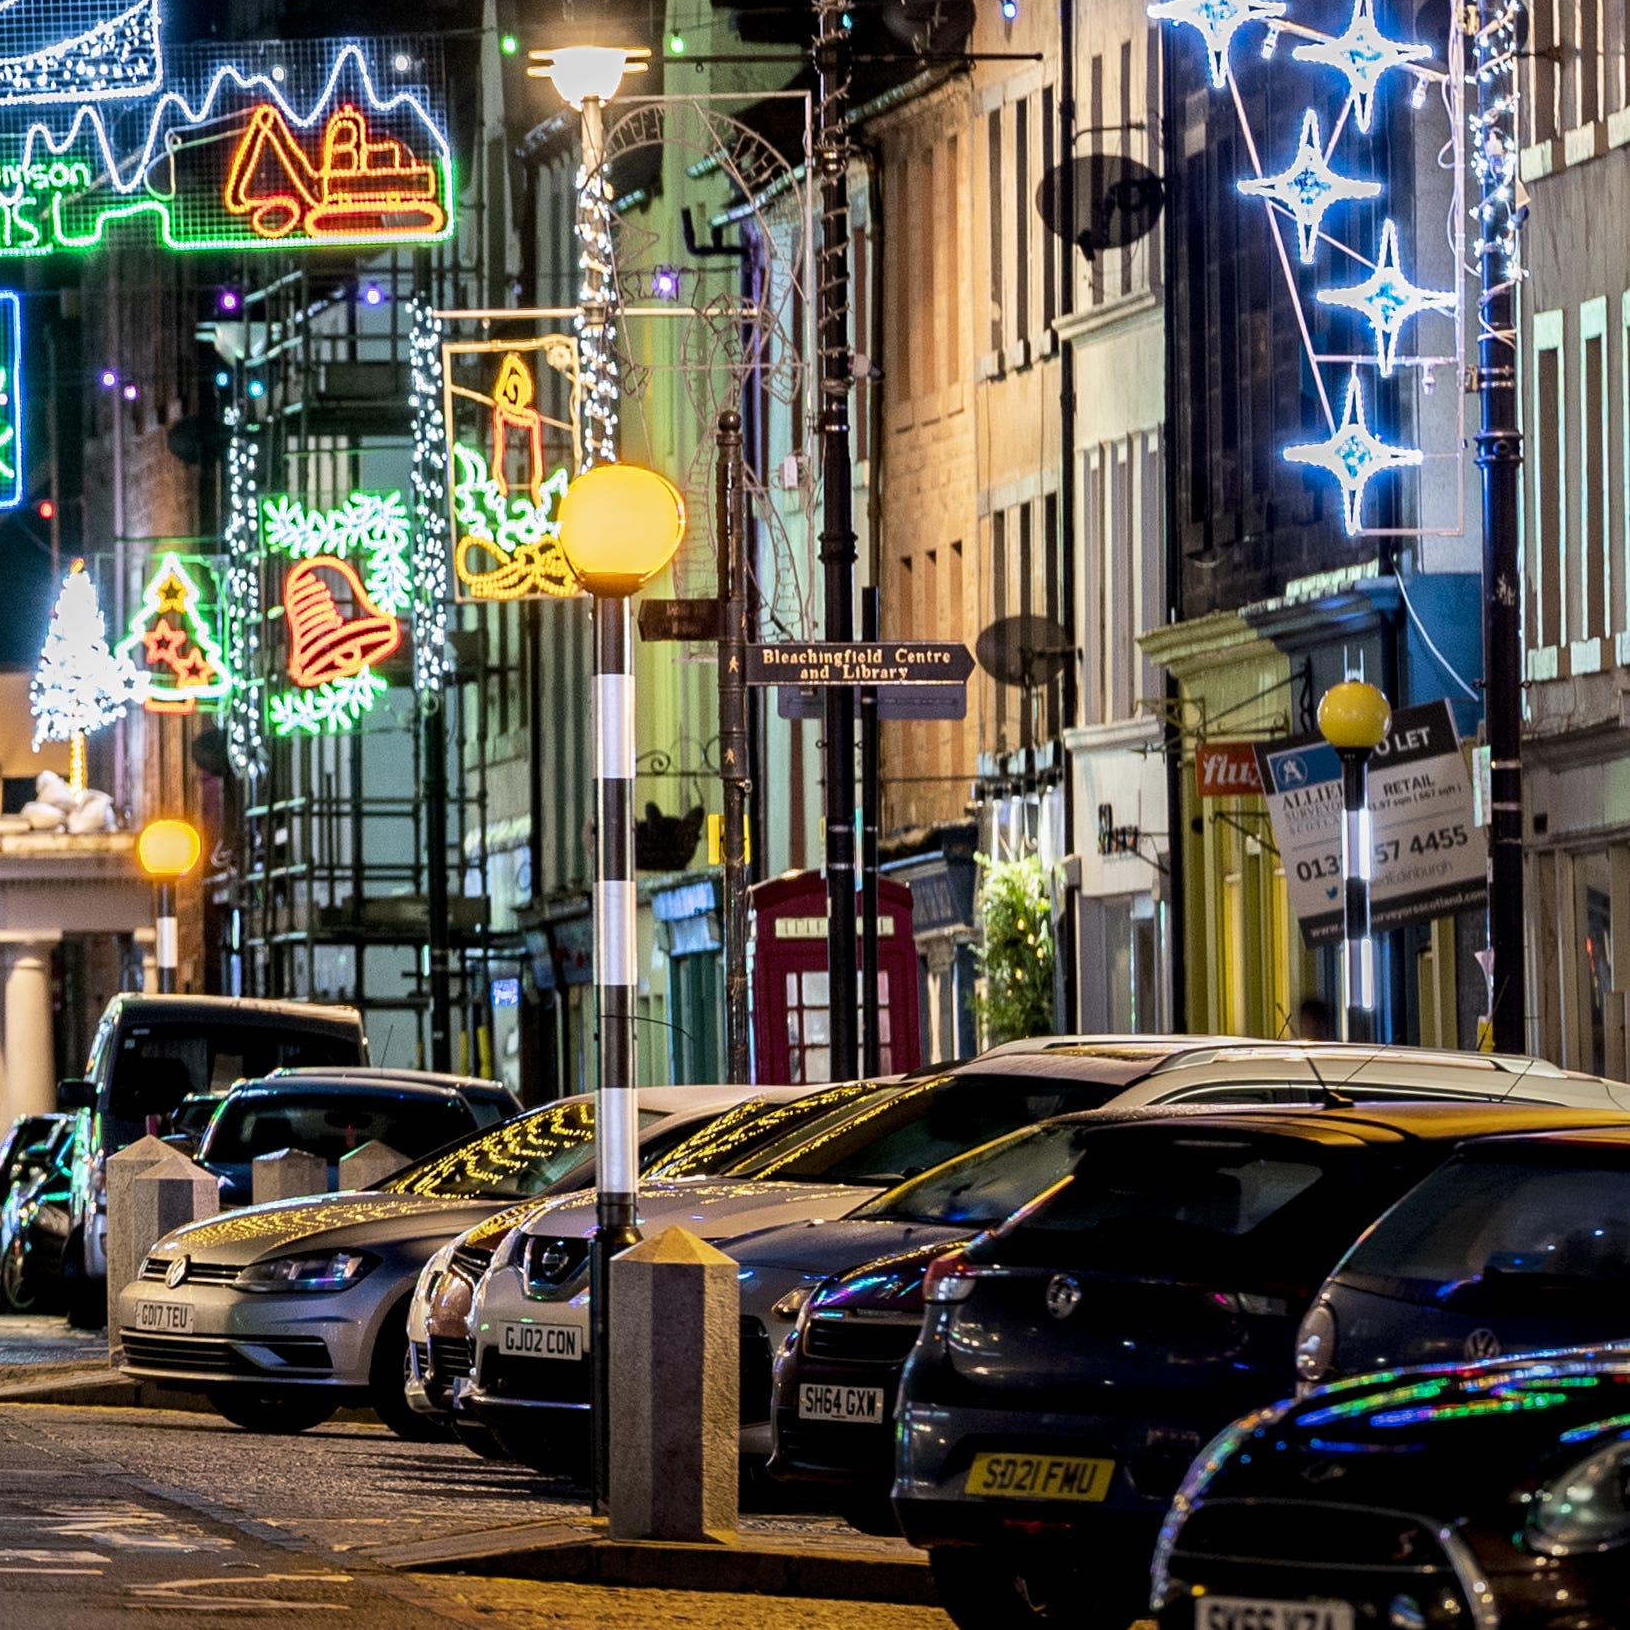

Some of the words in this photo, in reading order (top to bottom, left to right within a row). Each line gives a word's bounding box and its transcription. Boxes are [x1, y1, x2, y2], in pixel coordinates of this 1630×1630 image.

[761, 648, 884, 669] Bleachingfield
[894, 648, 952, 665] Centre
[799, 665, 830, 680] and
[842, 664, 909, 683] Library
[1394, 726, 1432, 750] LET
[1382, 773, 1436, 798] RETAIL
[1409, 823, 1469, 856] 4455
[166, 1305, 188, 1329] TEU
[504, 1329, 544, 1353] GJ02
[547, 1331, 578, 1357] CON
[804, 1386, 842, 1415] SH64
[845, 1388, 877, 1417] GXW
[982, 1458, 1042, 1492] SD21
[1043, 1460, 1100, 1495] FMU
